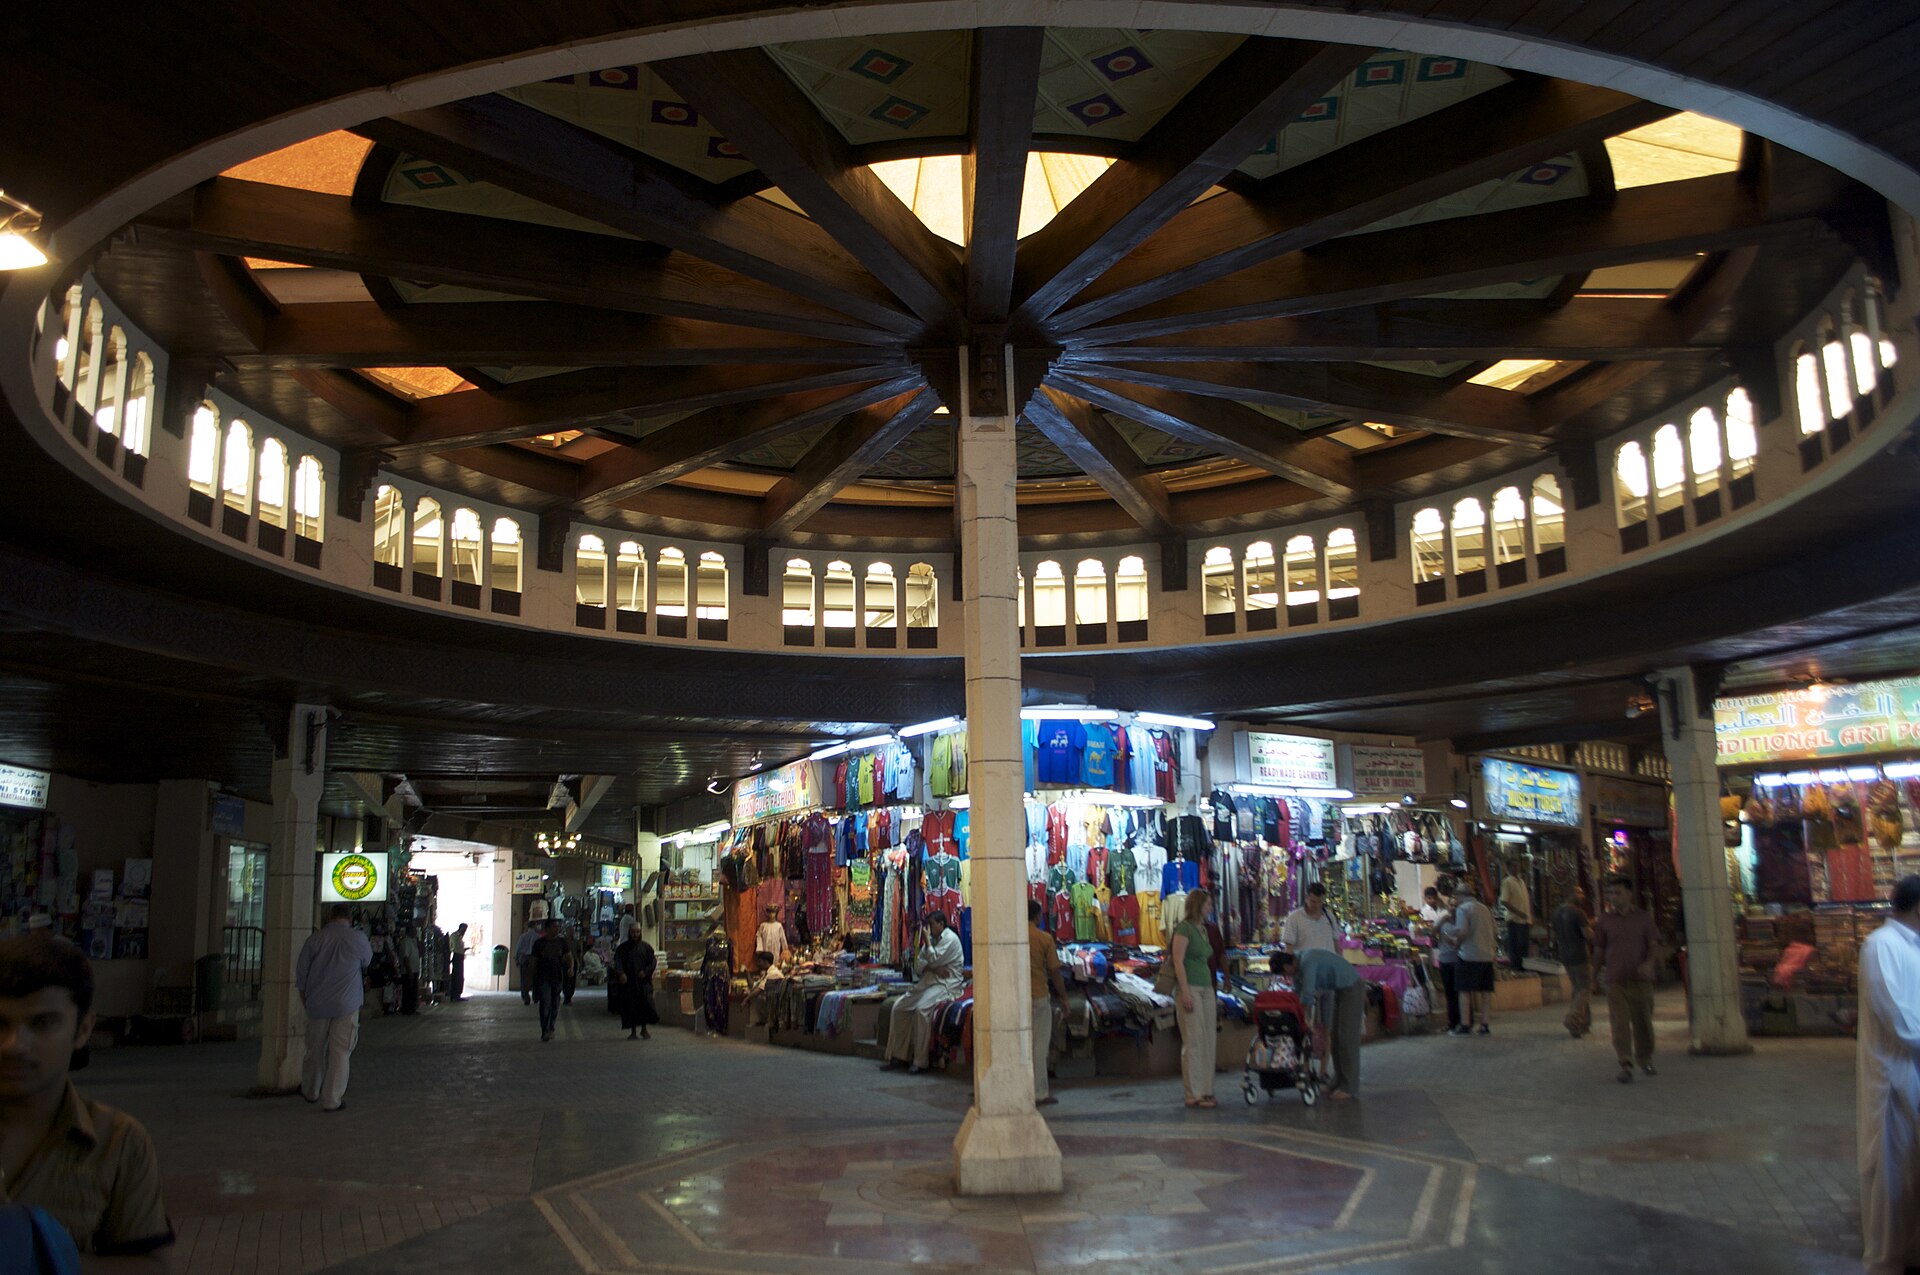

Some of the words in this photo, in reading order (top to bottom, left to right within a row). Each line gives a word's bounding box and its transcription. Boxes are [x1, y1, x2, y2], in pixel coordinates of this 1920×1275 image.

[1839, 723, 1888, 747] ART
[1260, 766, 1296, 779] READYMADE
[1299, 770, 1328, 781] GARMENTS
[13, 787, 42, 798] STORE
[755, 793, 769, 813] GULF
[770, 788, 795, 809] FASHION
[1506, 790, 1535, 809] MUSCAT
